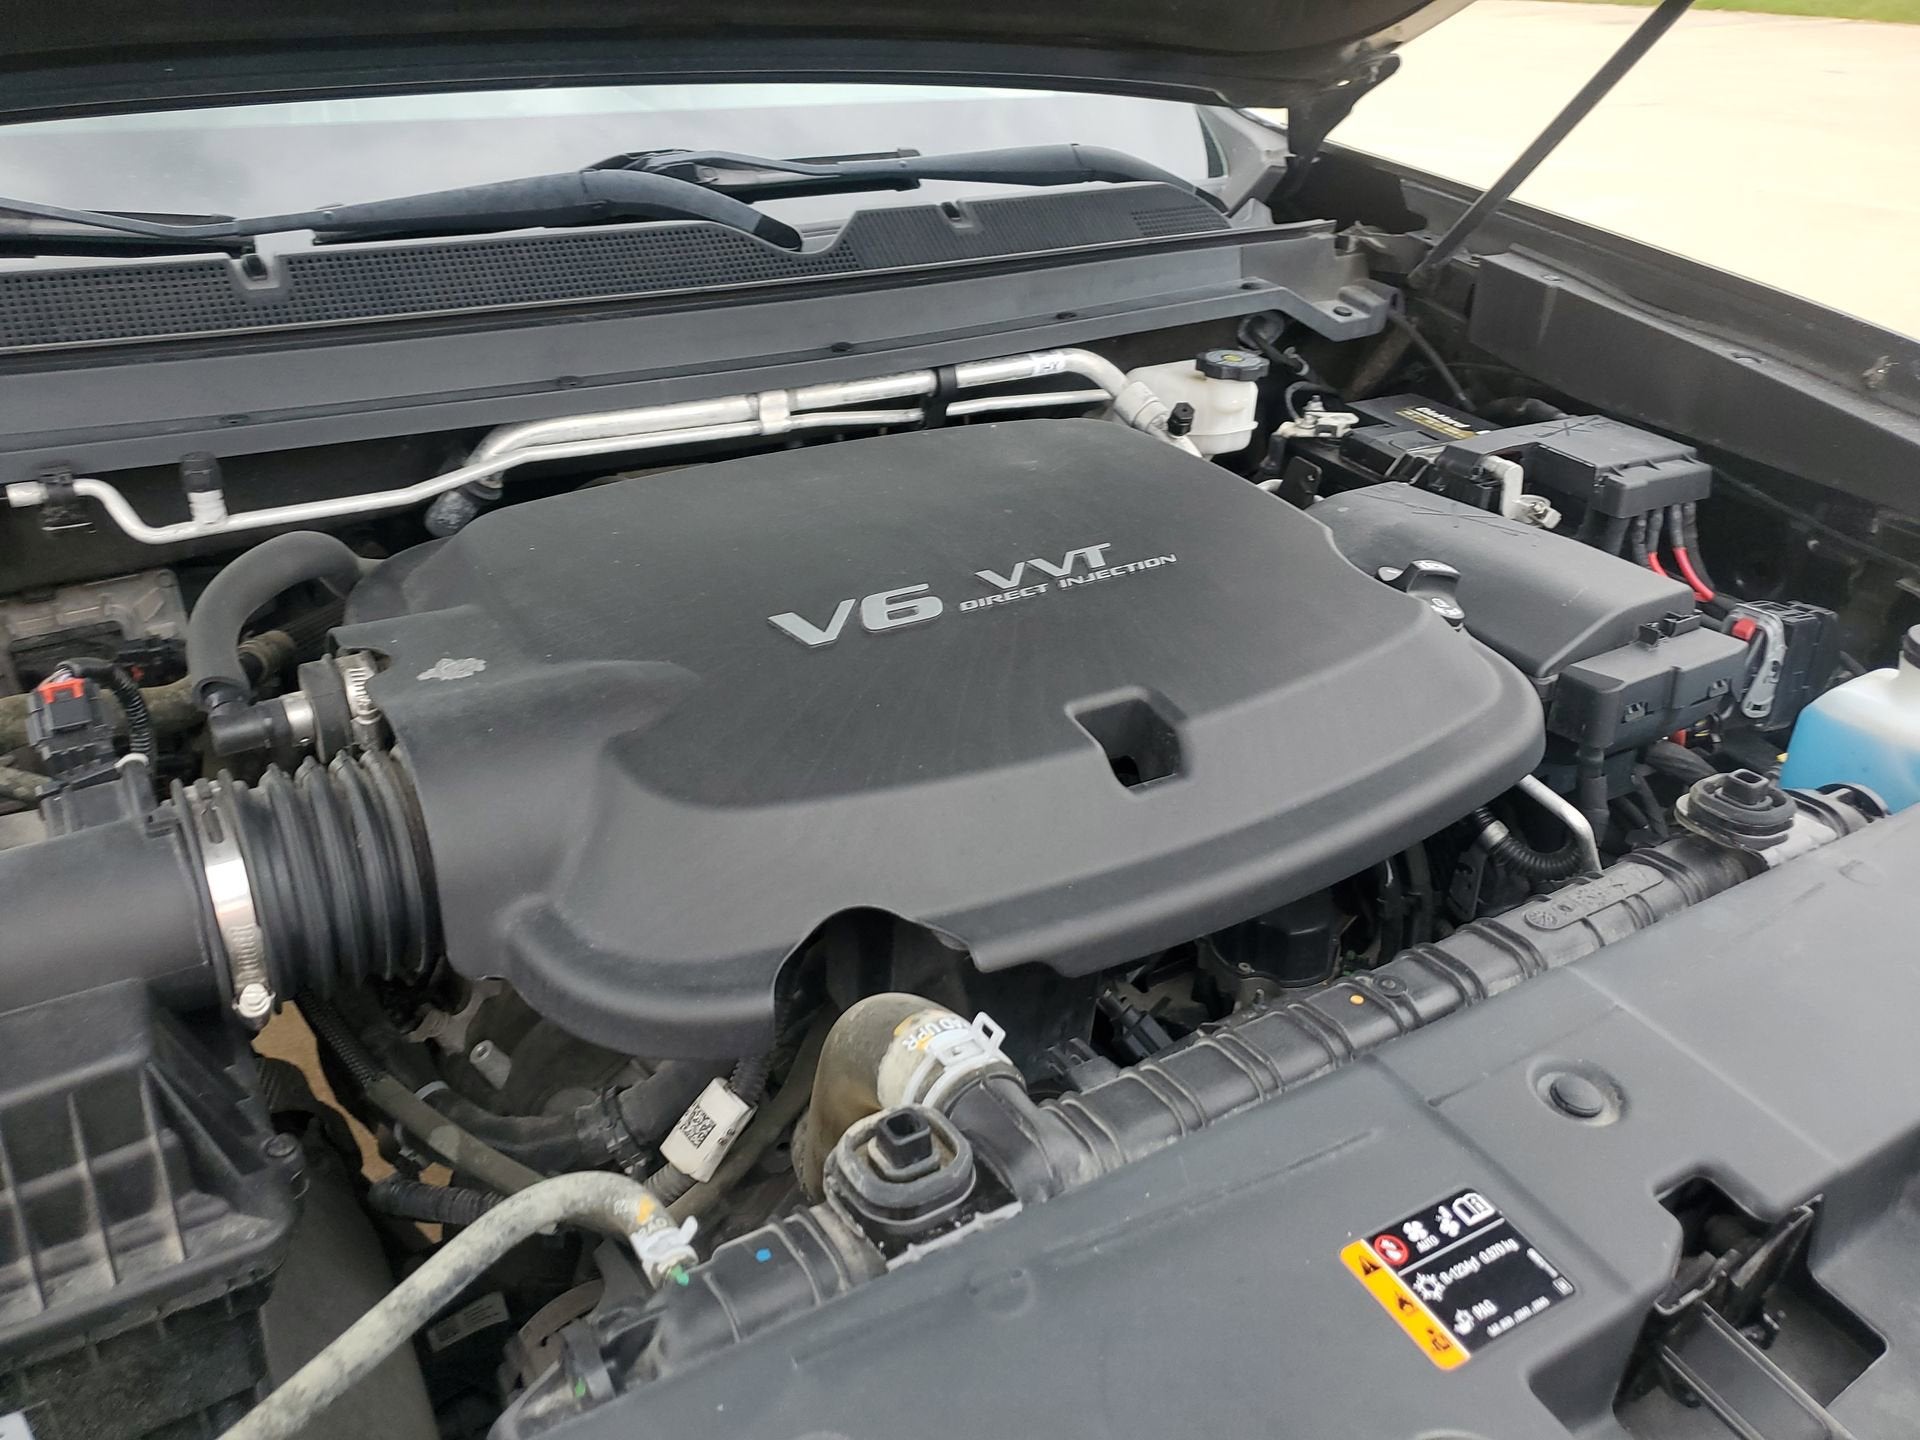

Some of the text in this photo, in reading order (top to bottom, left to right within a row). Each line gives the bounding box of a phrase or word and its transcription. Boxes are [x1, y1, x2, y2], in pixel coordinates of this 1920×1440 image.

[958, 553, 1178, 612] DIRECT INJECTION
[974, 542, 1111, 590] VVT
[767, 583, 944, 647] V6
[1416, 1234, 1440, 1253] AUTO
